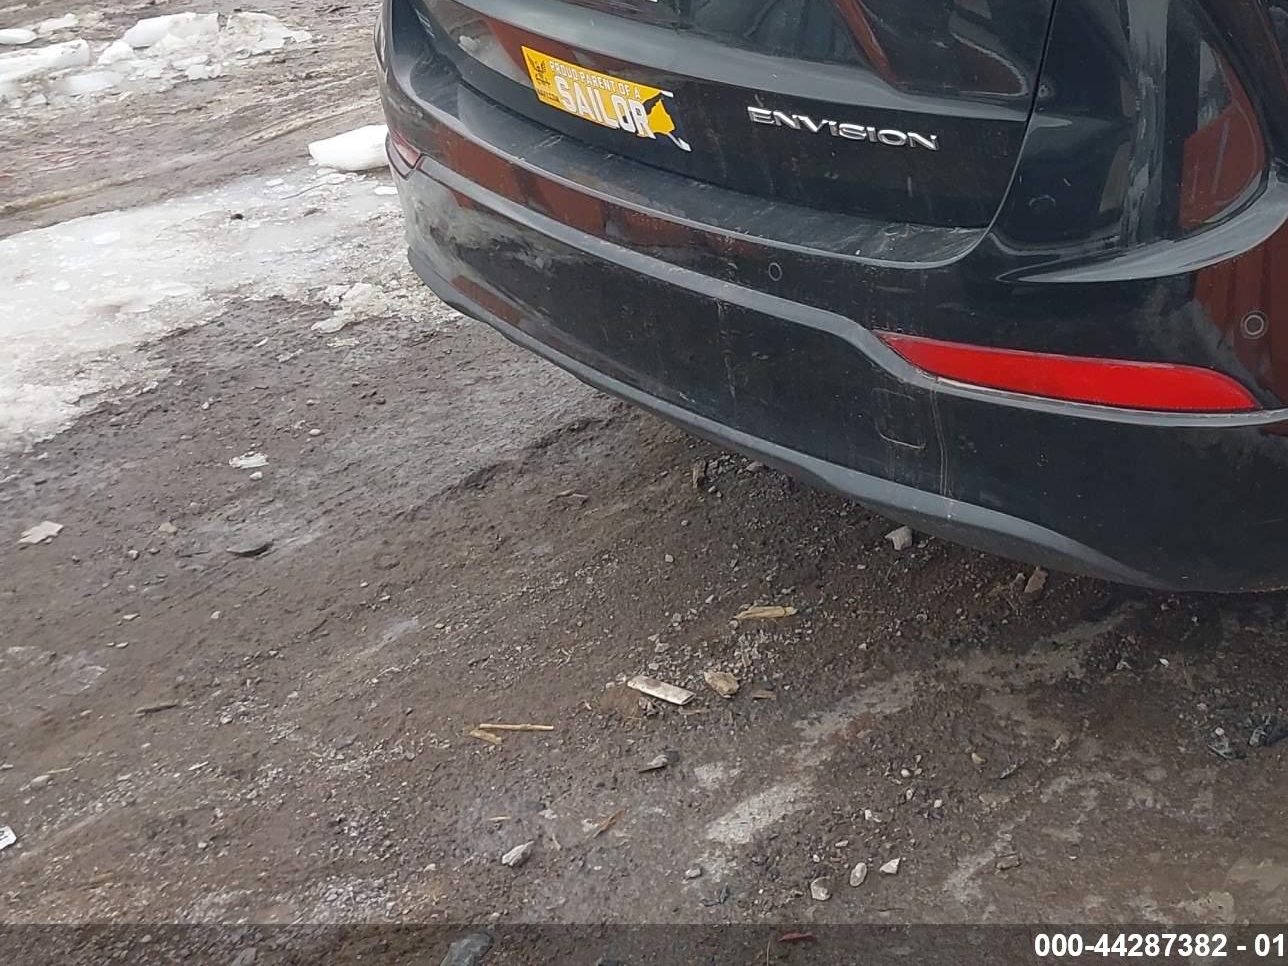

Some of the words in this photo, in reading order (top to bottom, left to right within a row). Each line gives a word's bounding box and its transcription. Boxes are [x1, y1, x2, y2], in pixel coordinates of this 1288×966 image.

[549, 60, 579, 81] PROUD
[579, 70, 616, 92] PARENT
[618, 82, 631, 96] OF
[633, 88, 641, 100] A
[554, 75, 656, 139] SAILOR
[747, 106, 939, 151] ENVISION
